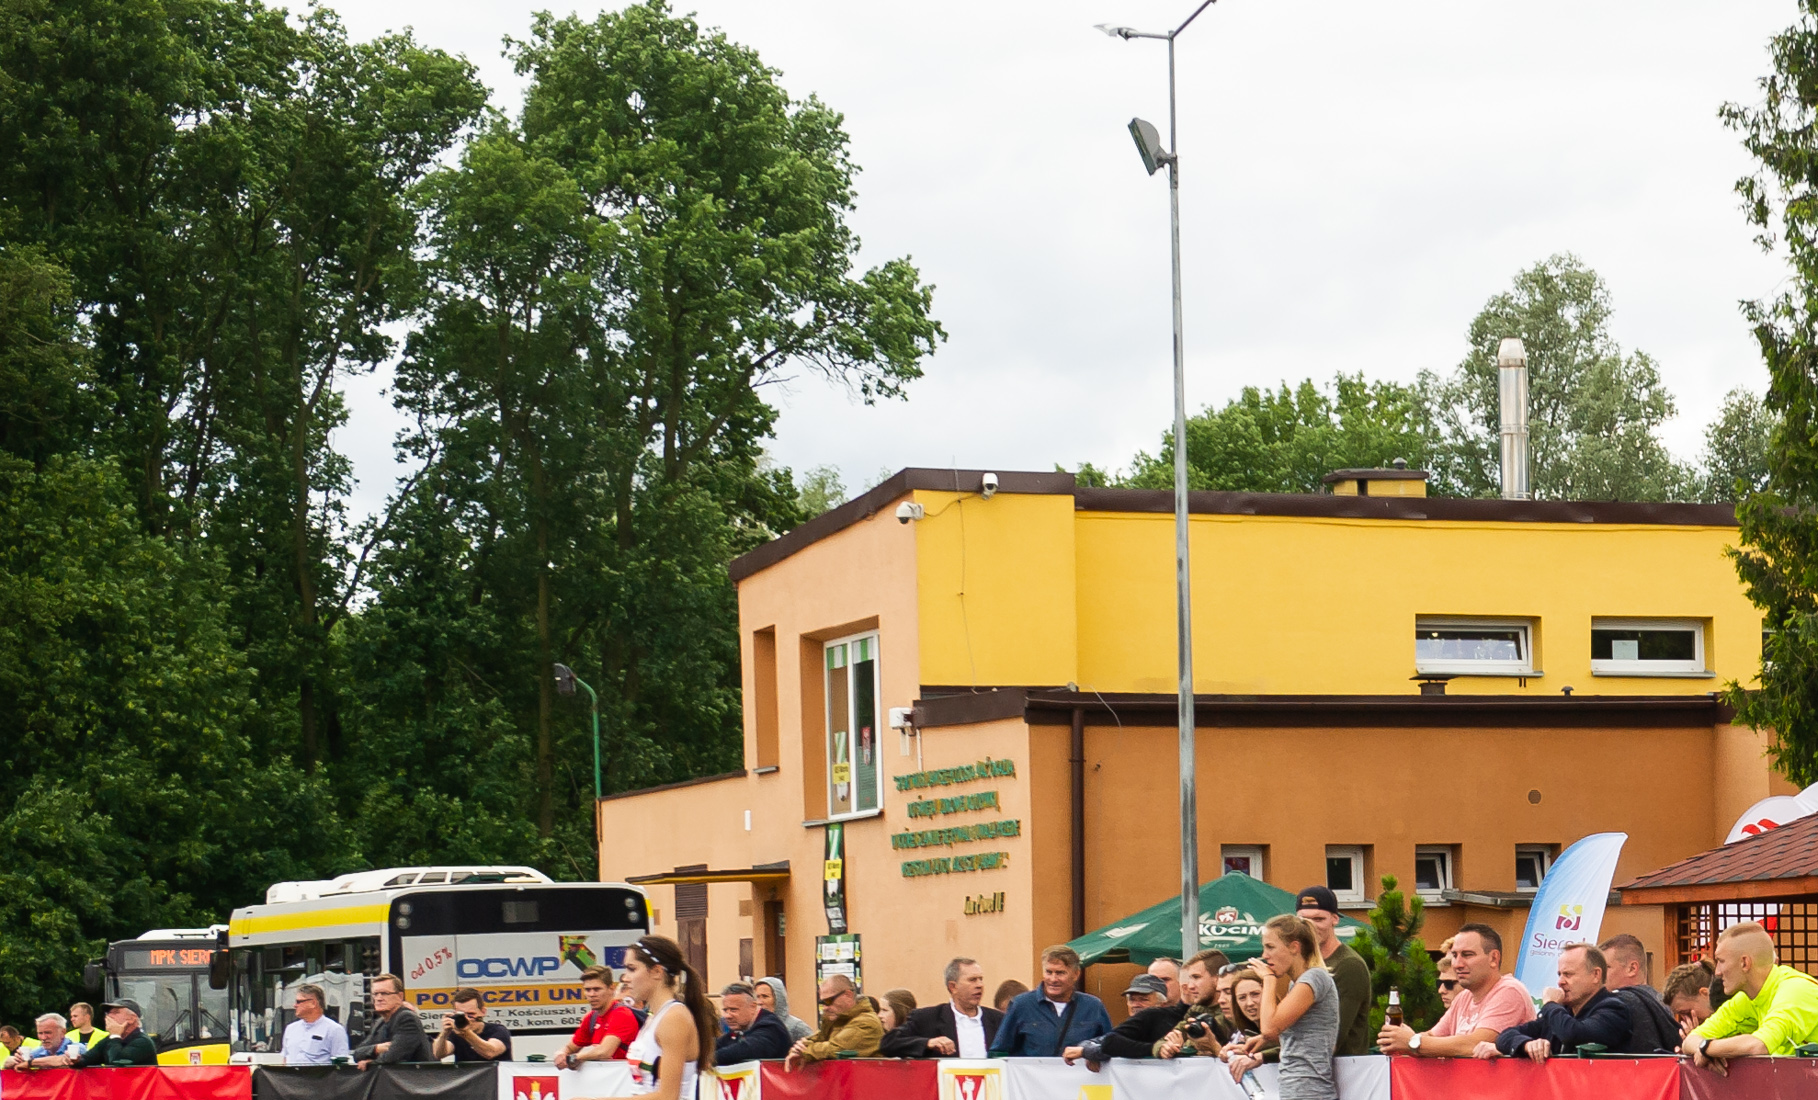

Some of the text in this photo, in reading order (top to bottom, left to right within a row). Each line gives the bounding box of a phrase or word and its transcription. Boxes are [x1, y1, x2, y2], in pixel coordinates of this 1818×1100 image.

[1181, 924, 1267, 936] KOCIM
[150, 949, 212, 965] MPK SIER
[411, 963, 425, 980] od
[457, 956, 560, 979] OCWP
[417, 988, 588, 1006] POCZKI UN
[419, 1012, 447, 1020] Sier
[508, 1006, 576, 1017] Kościuszki
[423, 1022, 439, 1030] el.
[527, 1018, 557, 1027] kom.
